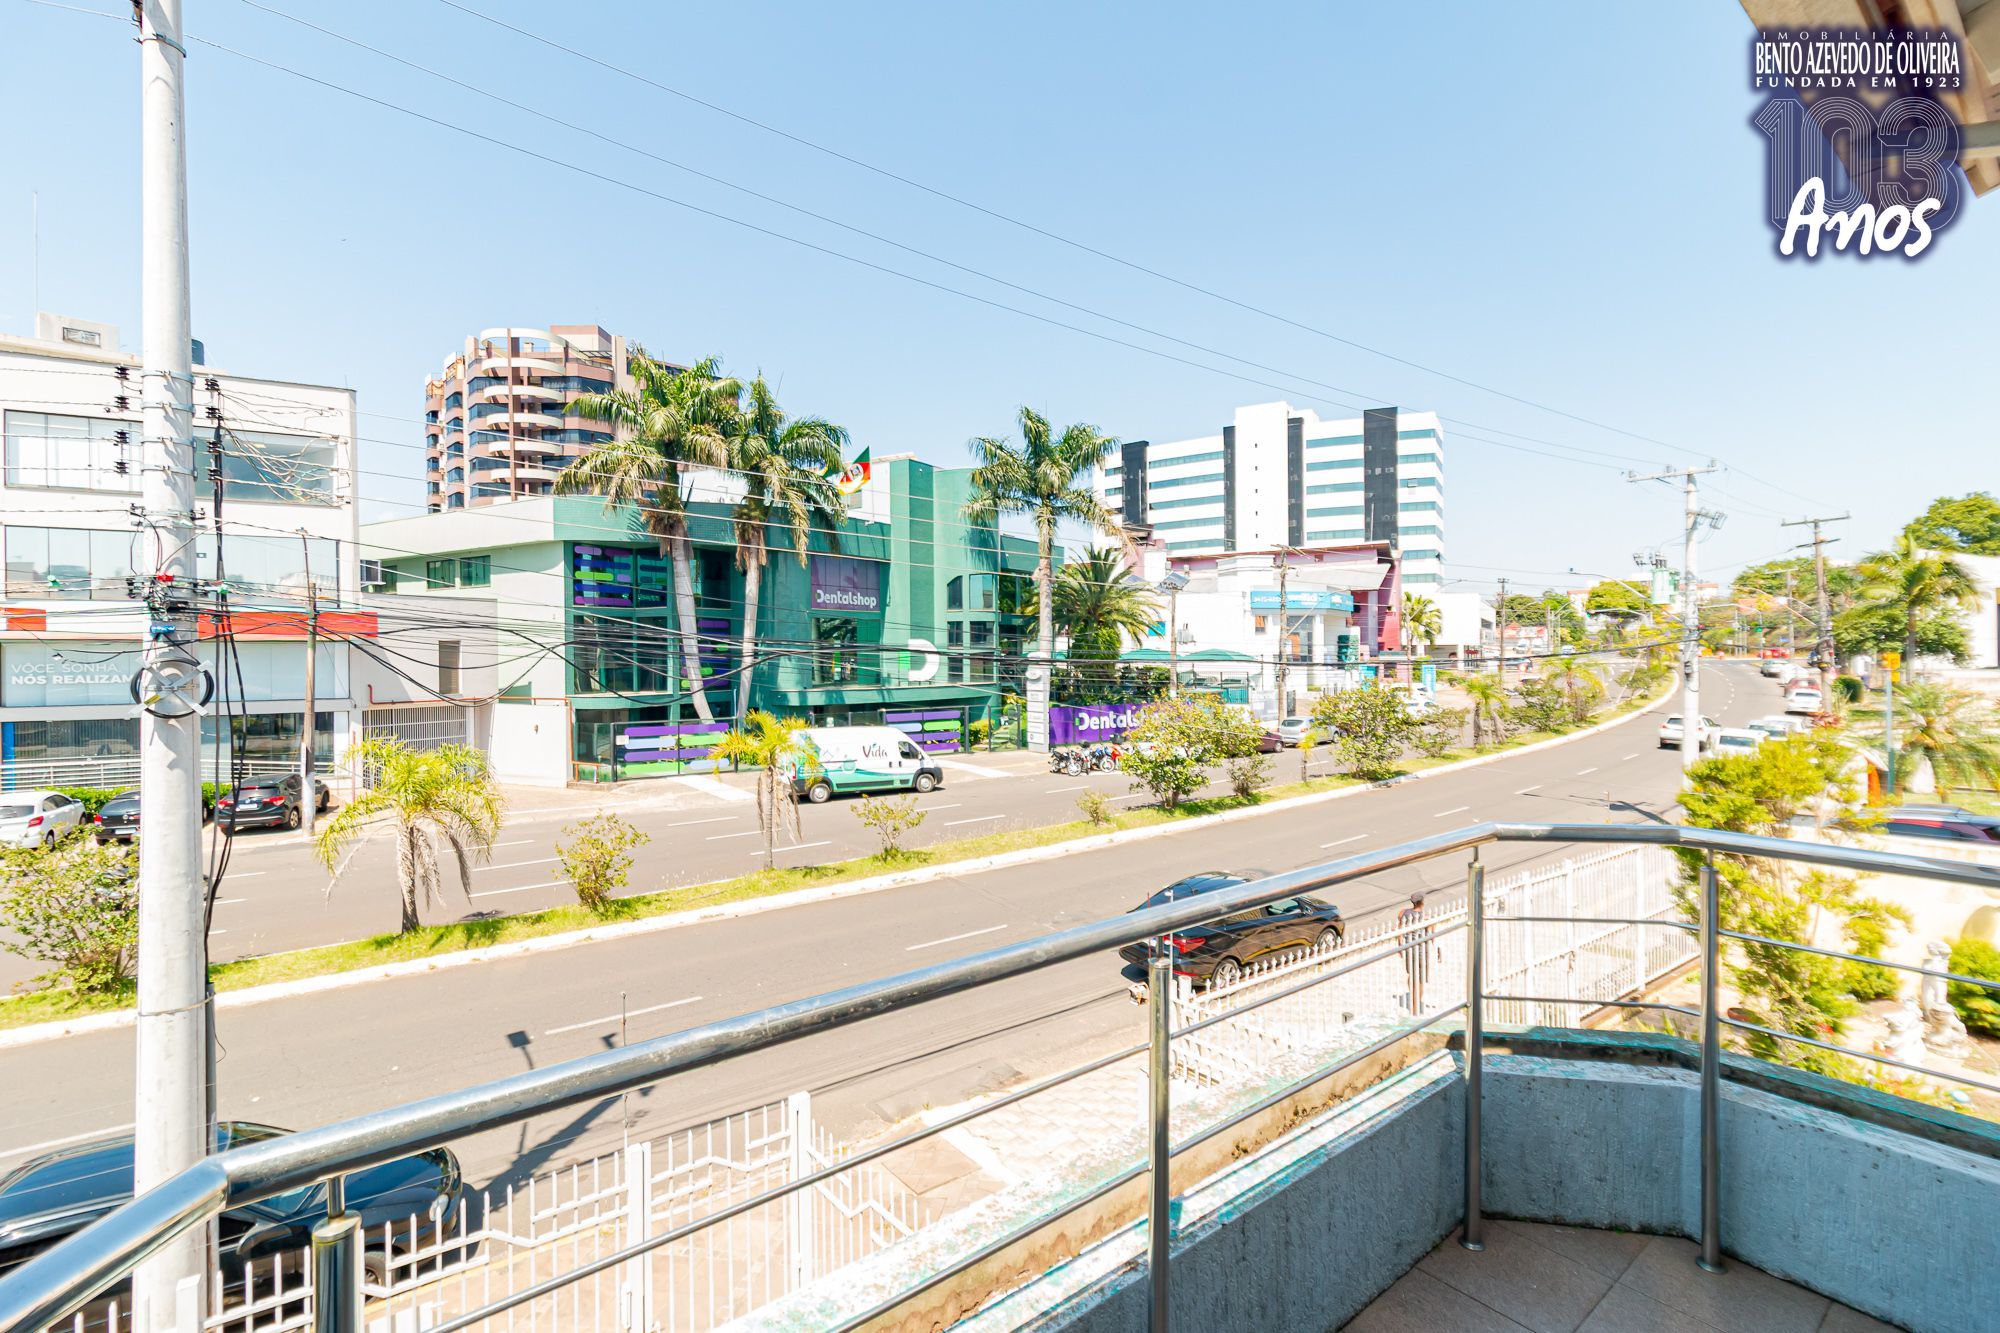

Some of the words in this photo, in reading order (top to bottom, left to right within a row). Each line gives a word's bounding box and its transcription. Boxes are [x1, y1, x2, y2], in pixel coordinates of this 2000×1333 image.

[815, 589, 877, 609] Dentalshop
[12, 673, 48, 685] NÓS
[862, 742, 889, 759] Vida
